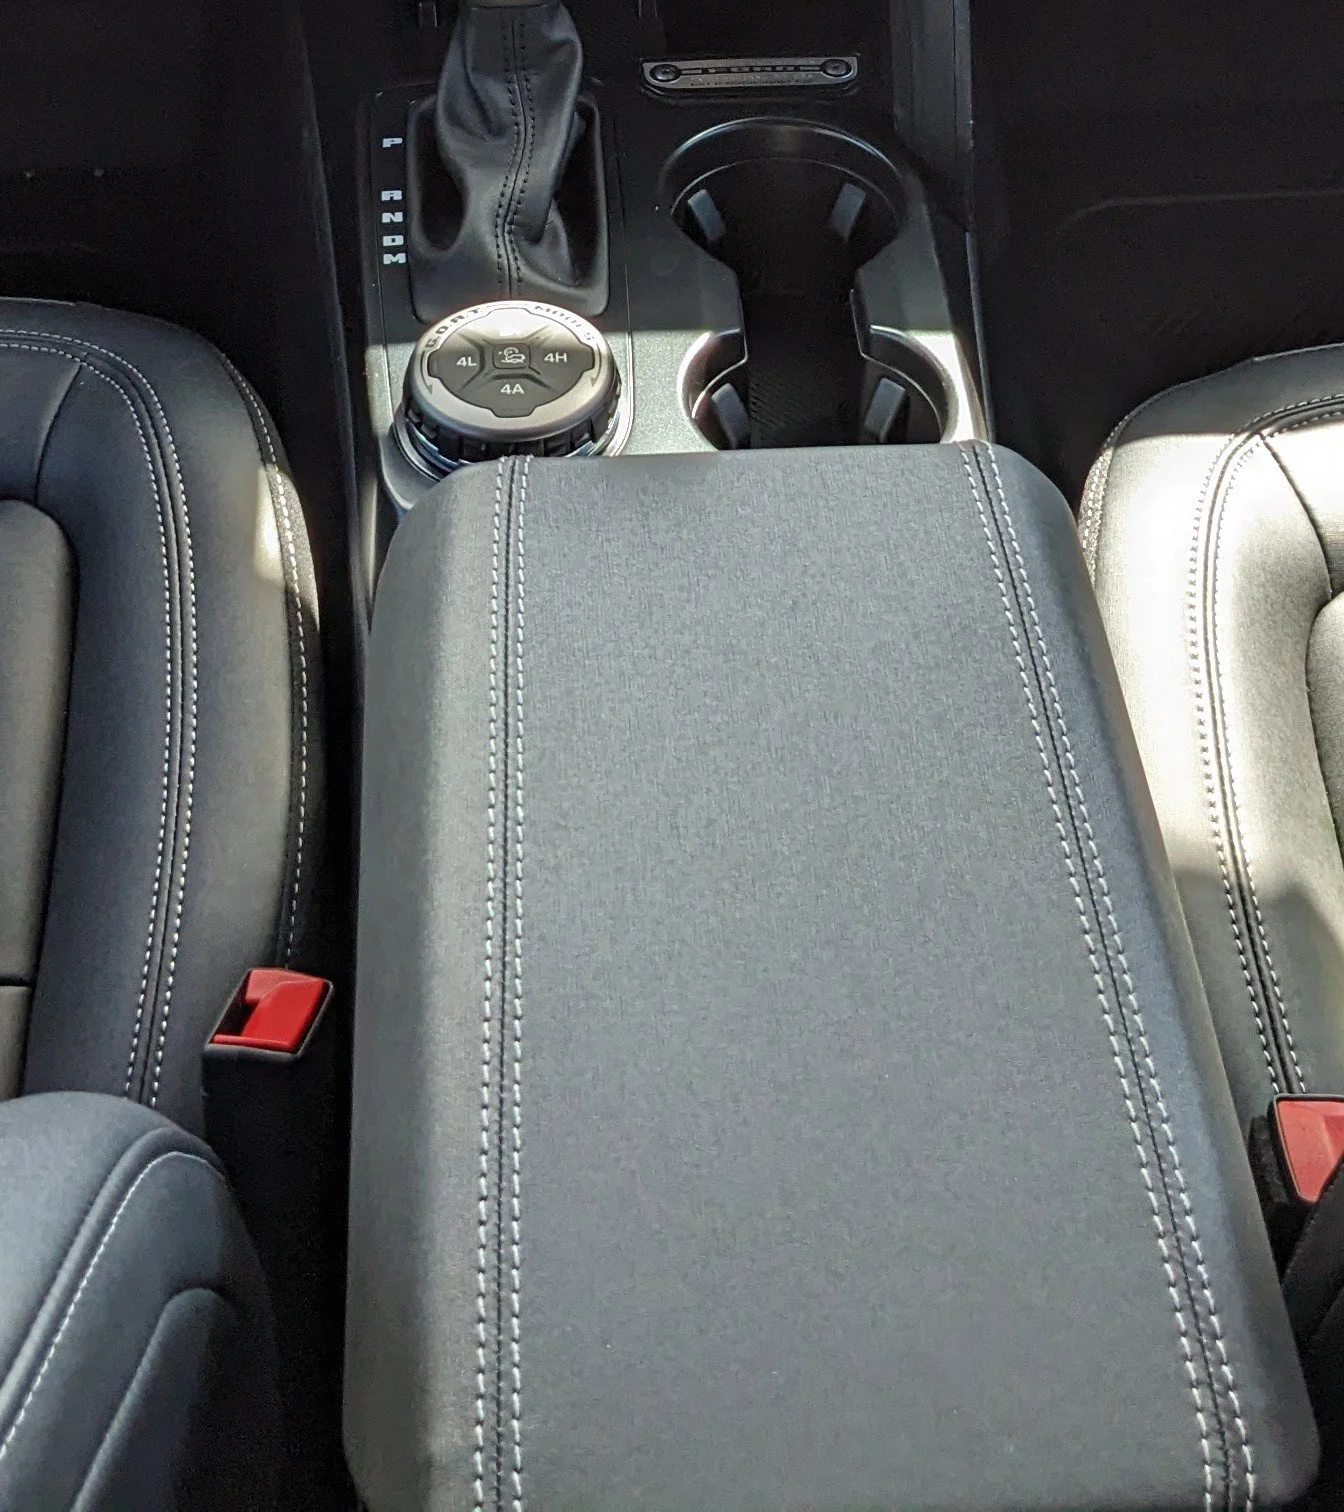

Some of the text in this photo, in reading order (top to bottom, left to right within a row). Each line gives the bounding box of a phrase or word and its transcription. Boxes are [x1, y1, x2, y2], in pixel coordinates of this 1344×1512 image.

[382, 137, 403, 148] P
[382, 212, 403, 223] N
[383, 253, 406, 264] M
[456, 356, 477, 367] 4L
[544, 353, 568, 363] 4H
[500, 384, 525, 395] 4A
